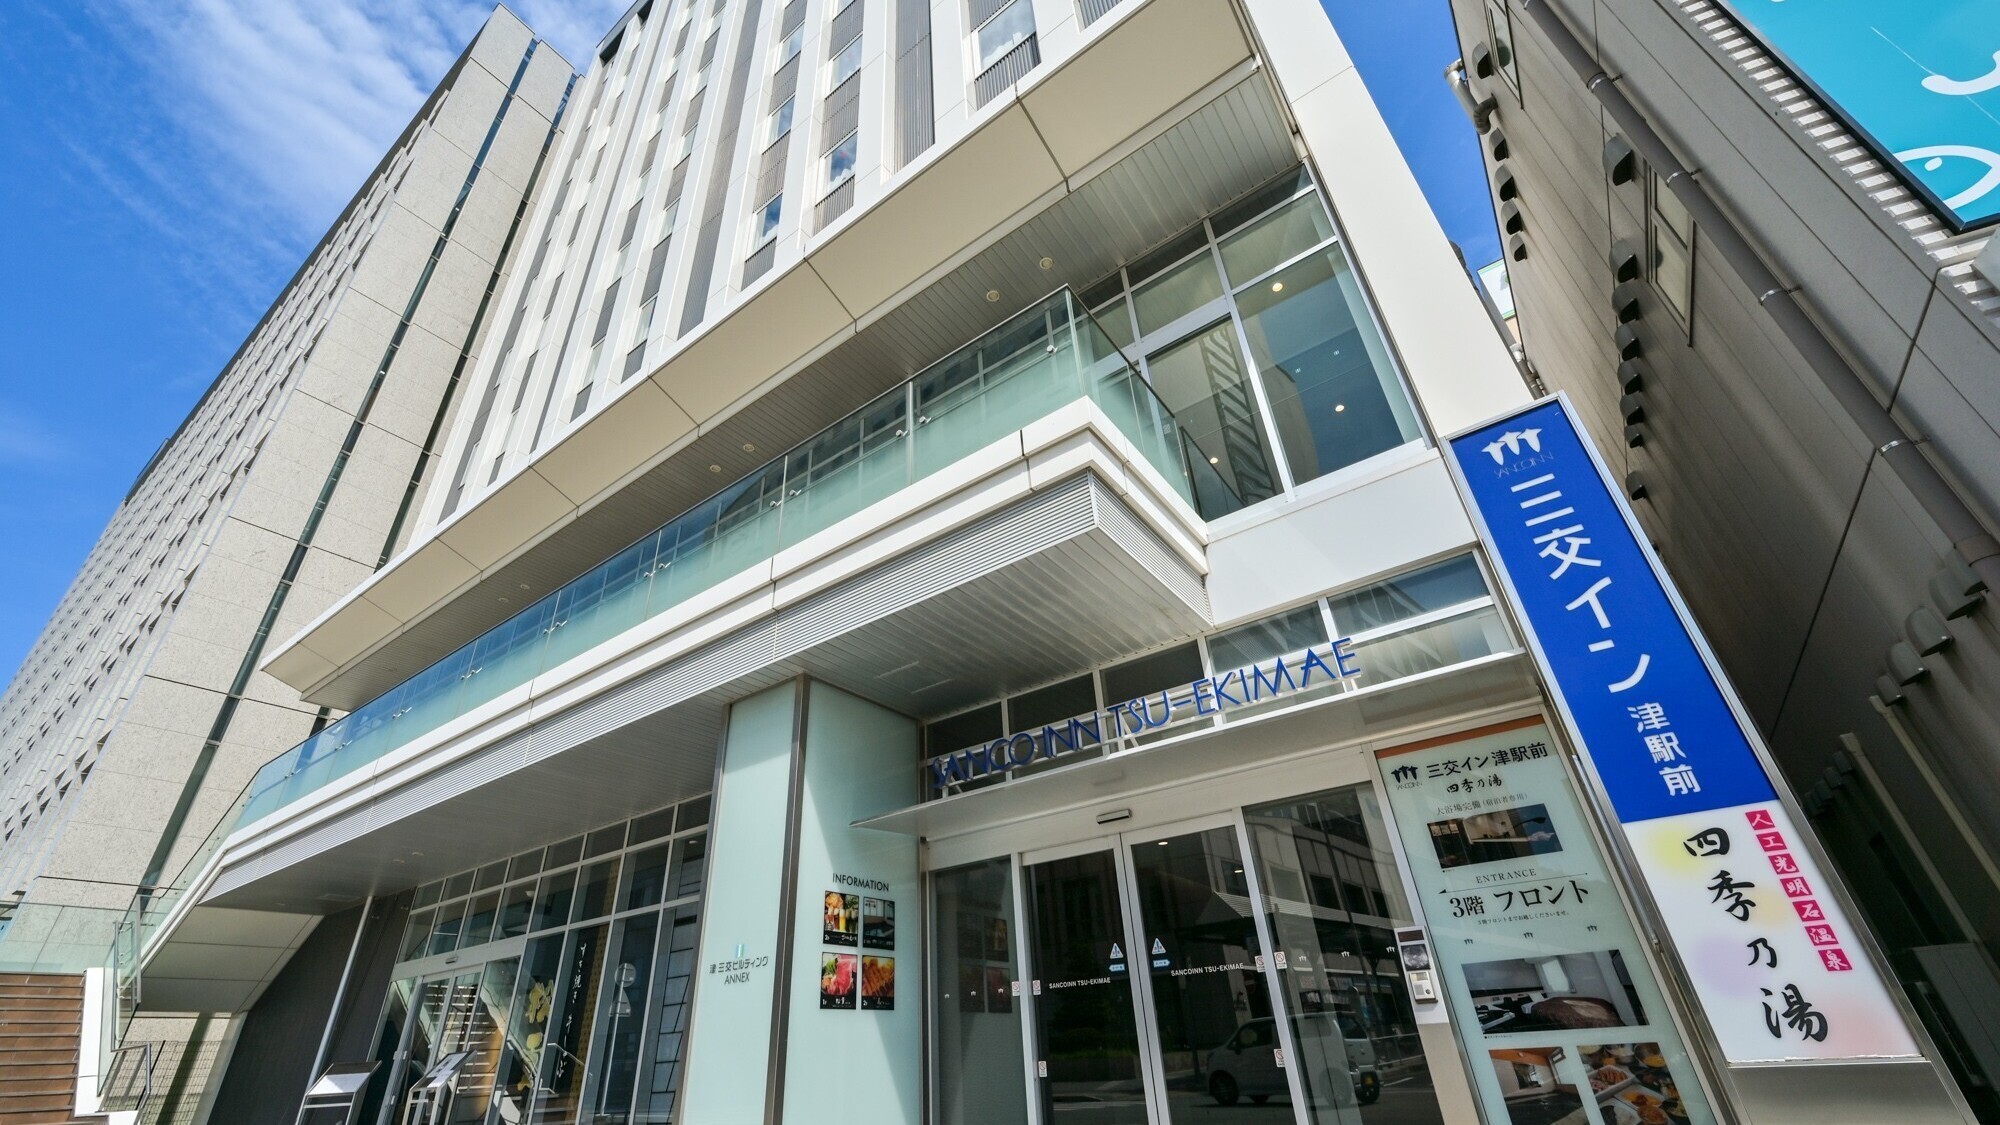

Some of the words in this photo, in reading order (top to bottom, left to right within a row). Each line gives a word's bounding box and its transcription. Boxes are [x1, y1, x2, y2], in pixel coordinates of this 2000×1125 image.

[1511, 474, 1650, 692] 三交イン
[1627, 703, 1702, 797] 津駅前
[932, 734, 1038, 789] SANCO
[1043, 713, 1104, 757] INN
[1108, 637, 1362, 737] TSU-EKIMAE
[1426, 743, 1548, 779] 三交イン津駅前
[1447, 773, 1502, 794] 四季乃湯
[832, 873, 890, 892] INFORMATION
[1476, 869, 1537, 884] ENTRANCE
[1748, 810, 1851, 971] 人工光明石温泉
[1449, 895, 1485, 918] 3階
[1493, 880, 1589, 912] フロント
[1684, 827, 1828, 1041] 四季乃湯
[724, 972, 750, 985] ANNEX
[1048, 980, 1077, 989] SANCOINN
[1077, 977, 1111, 987] TSU-EKIMAE
[1171, 968, 1203, 977] SANCOINN
[1204, 963, 1244, 973] TSU-EKIMAE
